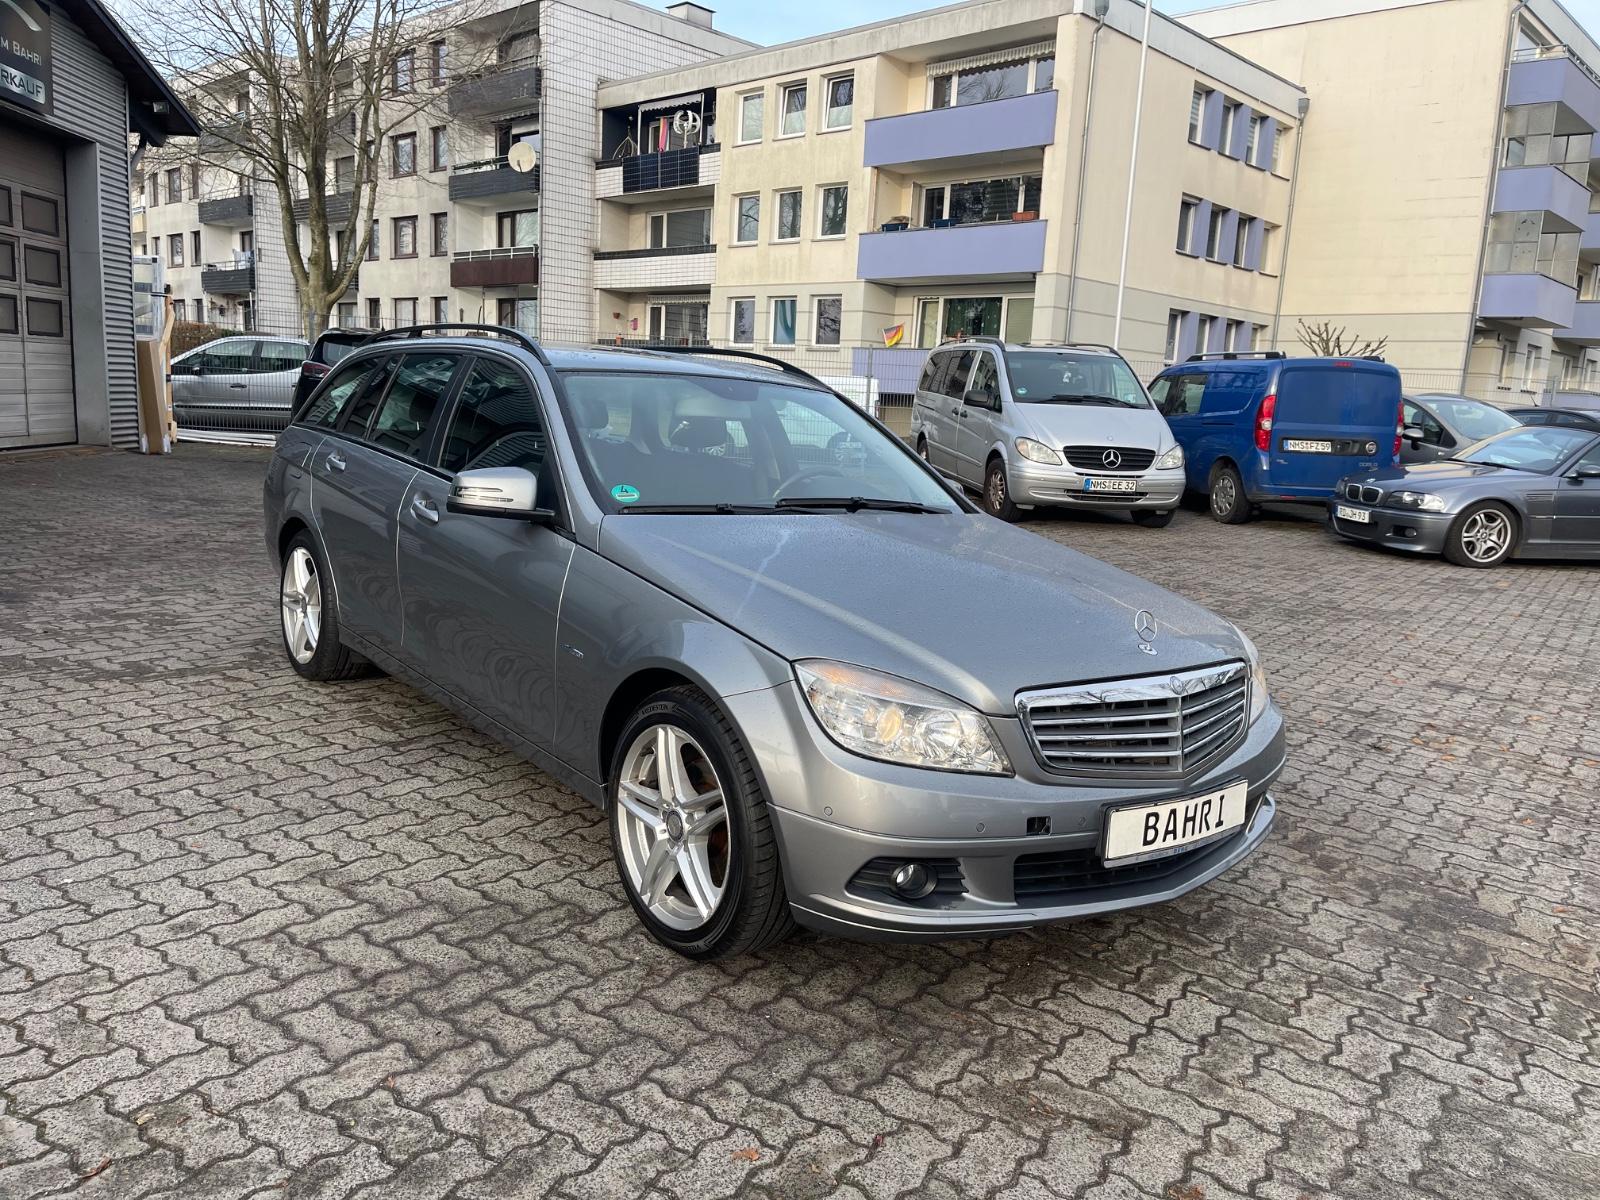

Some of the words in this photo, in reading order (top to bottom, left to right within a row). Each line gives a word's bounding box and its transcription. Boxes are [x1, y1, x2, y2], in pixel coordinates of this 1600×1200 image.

[12, 40, 42, 66] BAHRI
[0, 68, 43, 97] RKAUF
[1090, 480, 1107, 490] NMS
[1111, 481, 1123, 490] EE
[1124, 481, 1135, 491] 32
[1142, 794, 1225, 847] BAHRI
